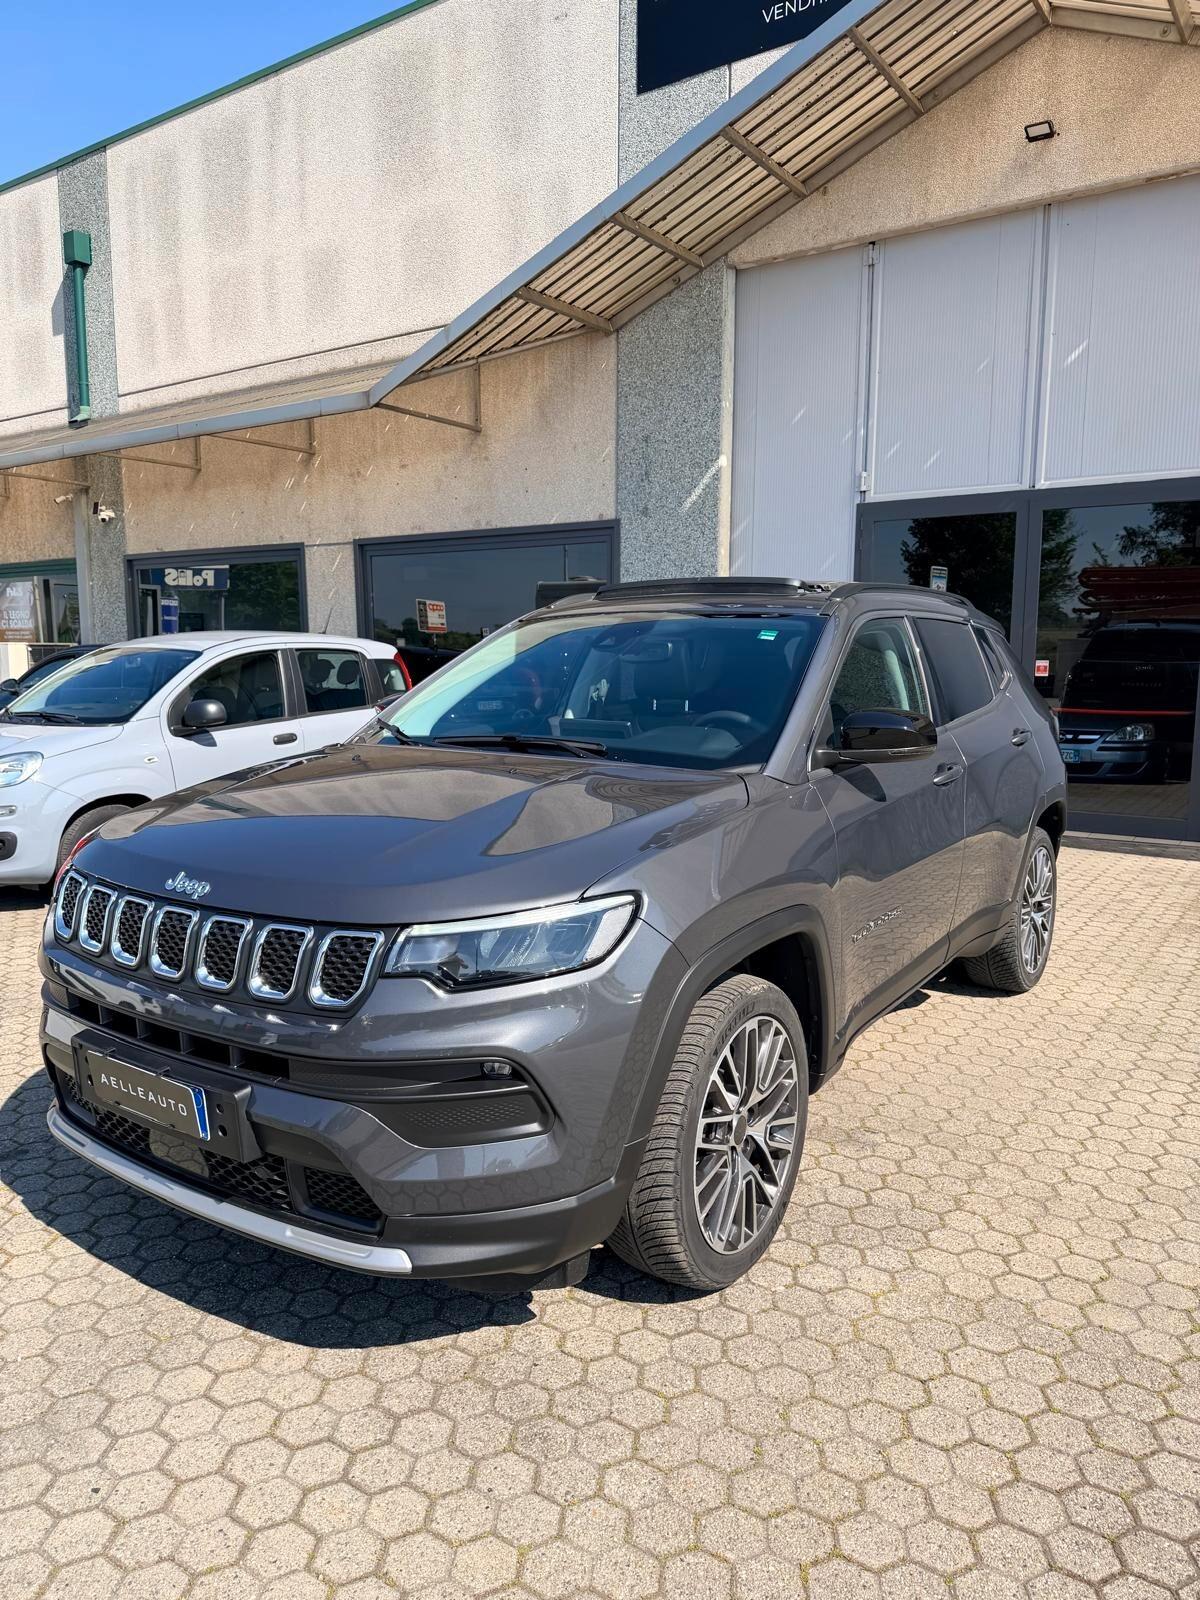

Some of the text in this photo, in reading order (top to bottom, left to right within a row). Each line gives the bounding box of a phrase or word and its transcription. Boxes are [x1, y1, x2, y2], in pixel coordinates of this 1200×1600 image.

[762, 0, 828, 23] VEND
[165, 871, 210, 900] Jeep
[100, 1073, 188, 1116] AELLEAUTO
